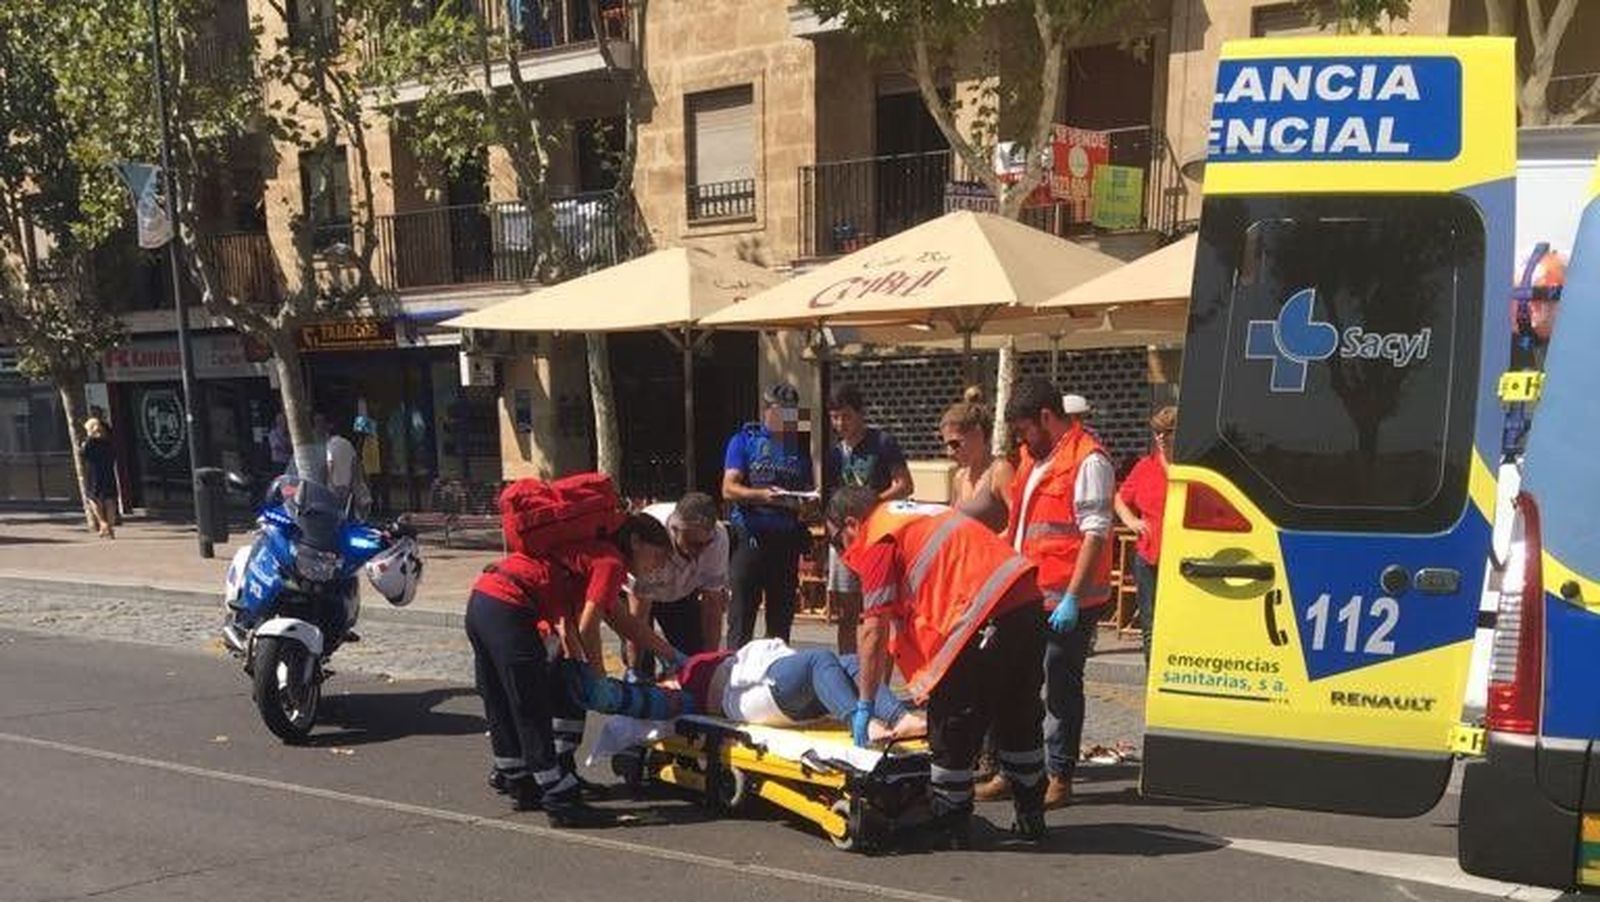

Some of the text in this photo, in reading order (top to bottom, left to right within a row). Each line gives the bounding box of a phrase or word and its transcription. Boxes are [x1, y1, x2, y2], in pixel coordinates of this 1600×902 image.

[1214, 63, 1421, 102] ANCIA
[1339, 326, 1432, 367] Sacyl
[1306, 593, 1400, 655] 112
[1167, 653, 1281, 673] emergencias
[1330, 691, 1437, 712] RENAULT
